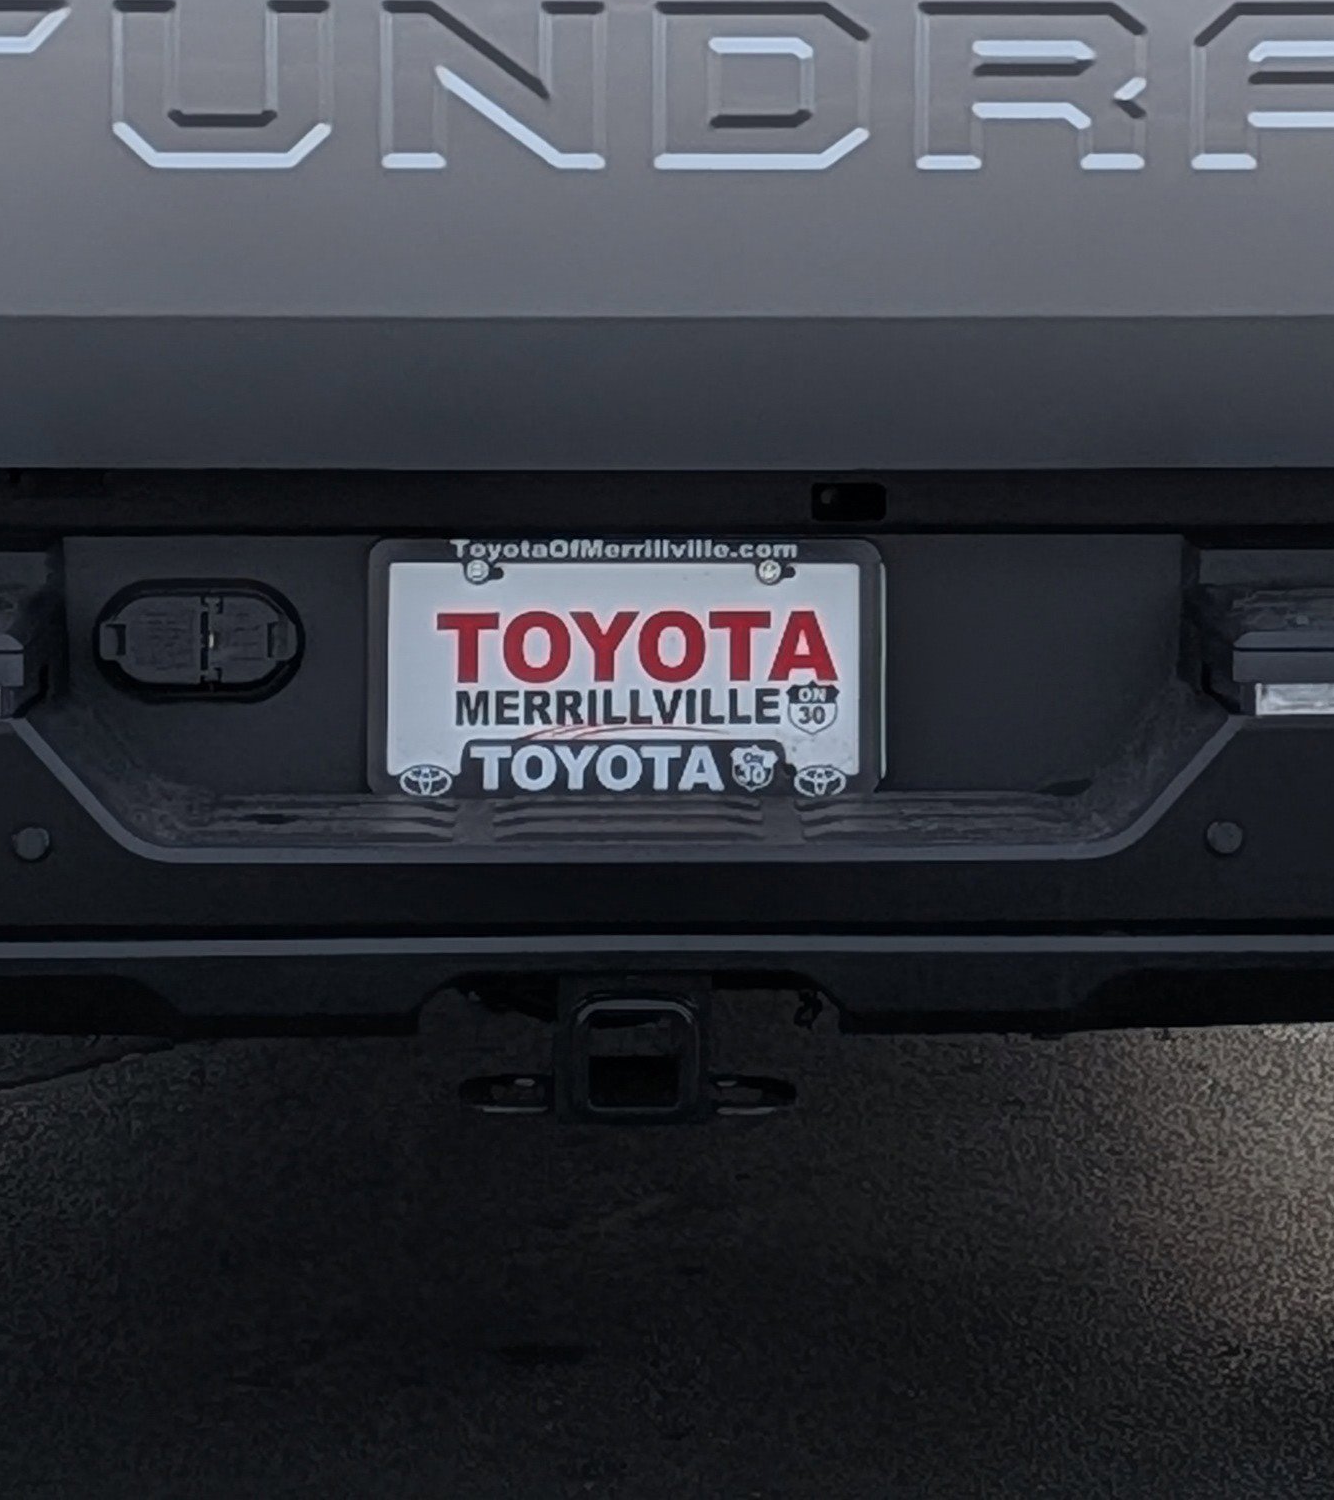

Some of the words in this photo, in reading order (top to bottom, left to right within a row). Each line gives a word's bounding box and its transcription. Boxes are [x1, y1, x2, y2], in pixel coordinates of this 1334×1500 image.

[450, 538, 799, 562] ToyotaOfMerrillville.com
[437, 611, 838, 683] TOYOTA
[455, 688, 781, 726] MERRILLVILLE
[798, 687, 827, 702] ON
[798, 705, 826, 725] 30
[470, 745, 726, 792] TOYOTA
